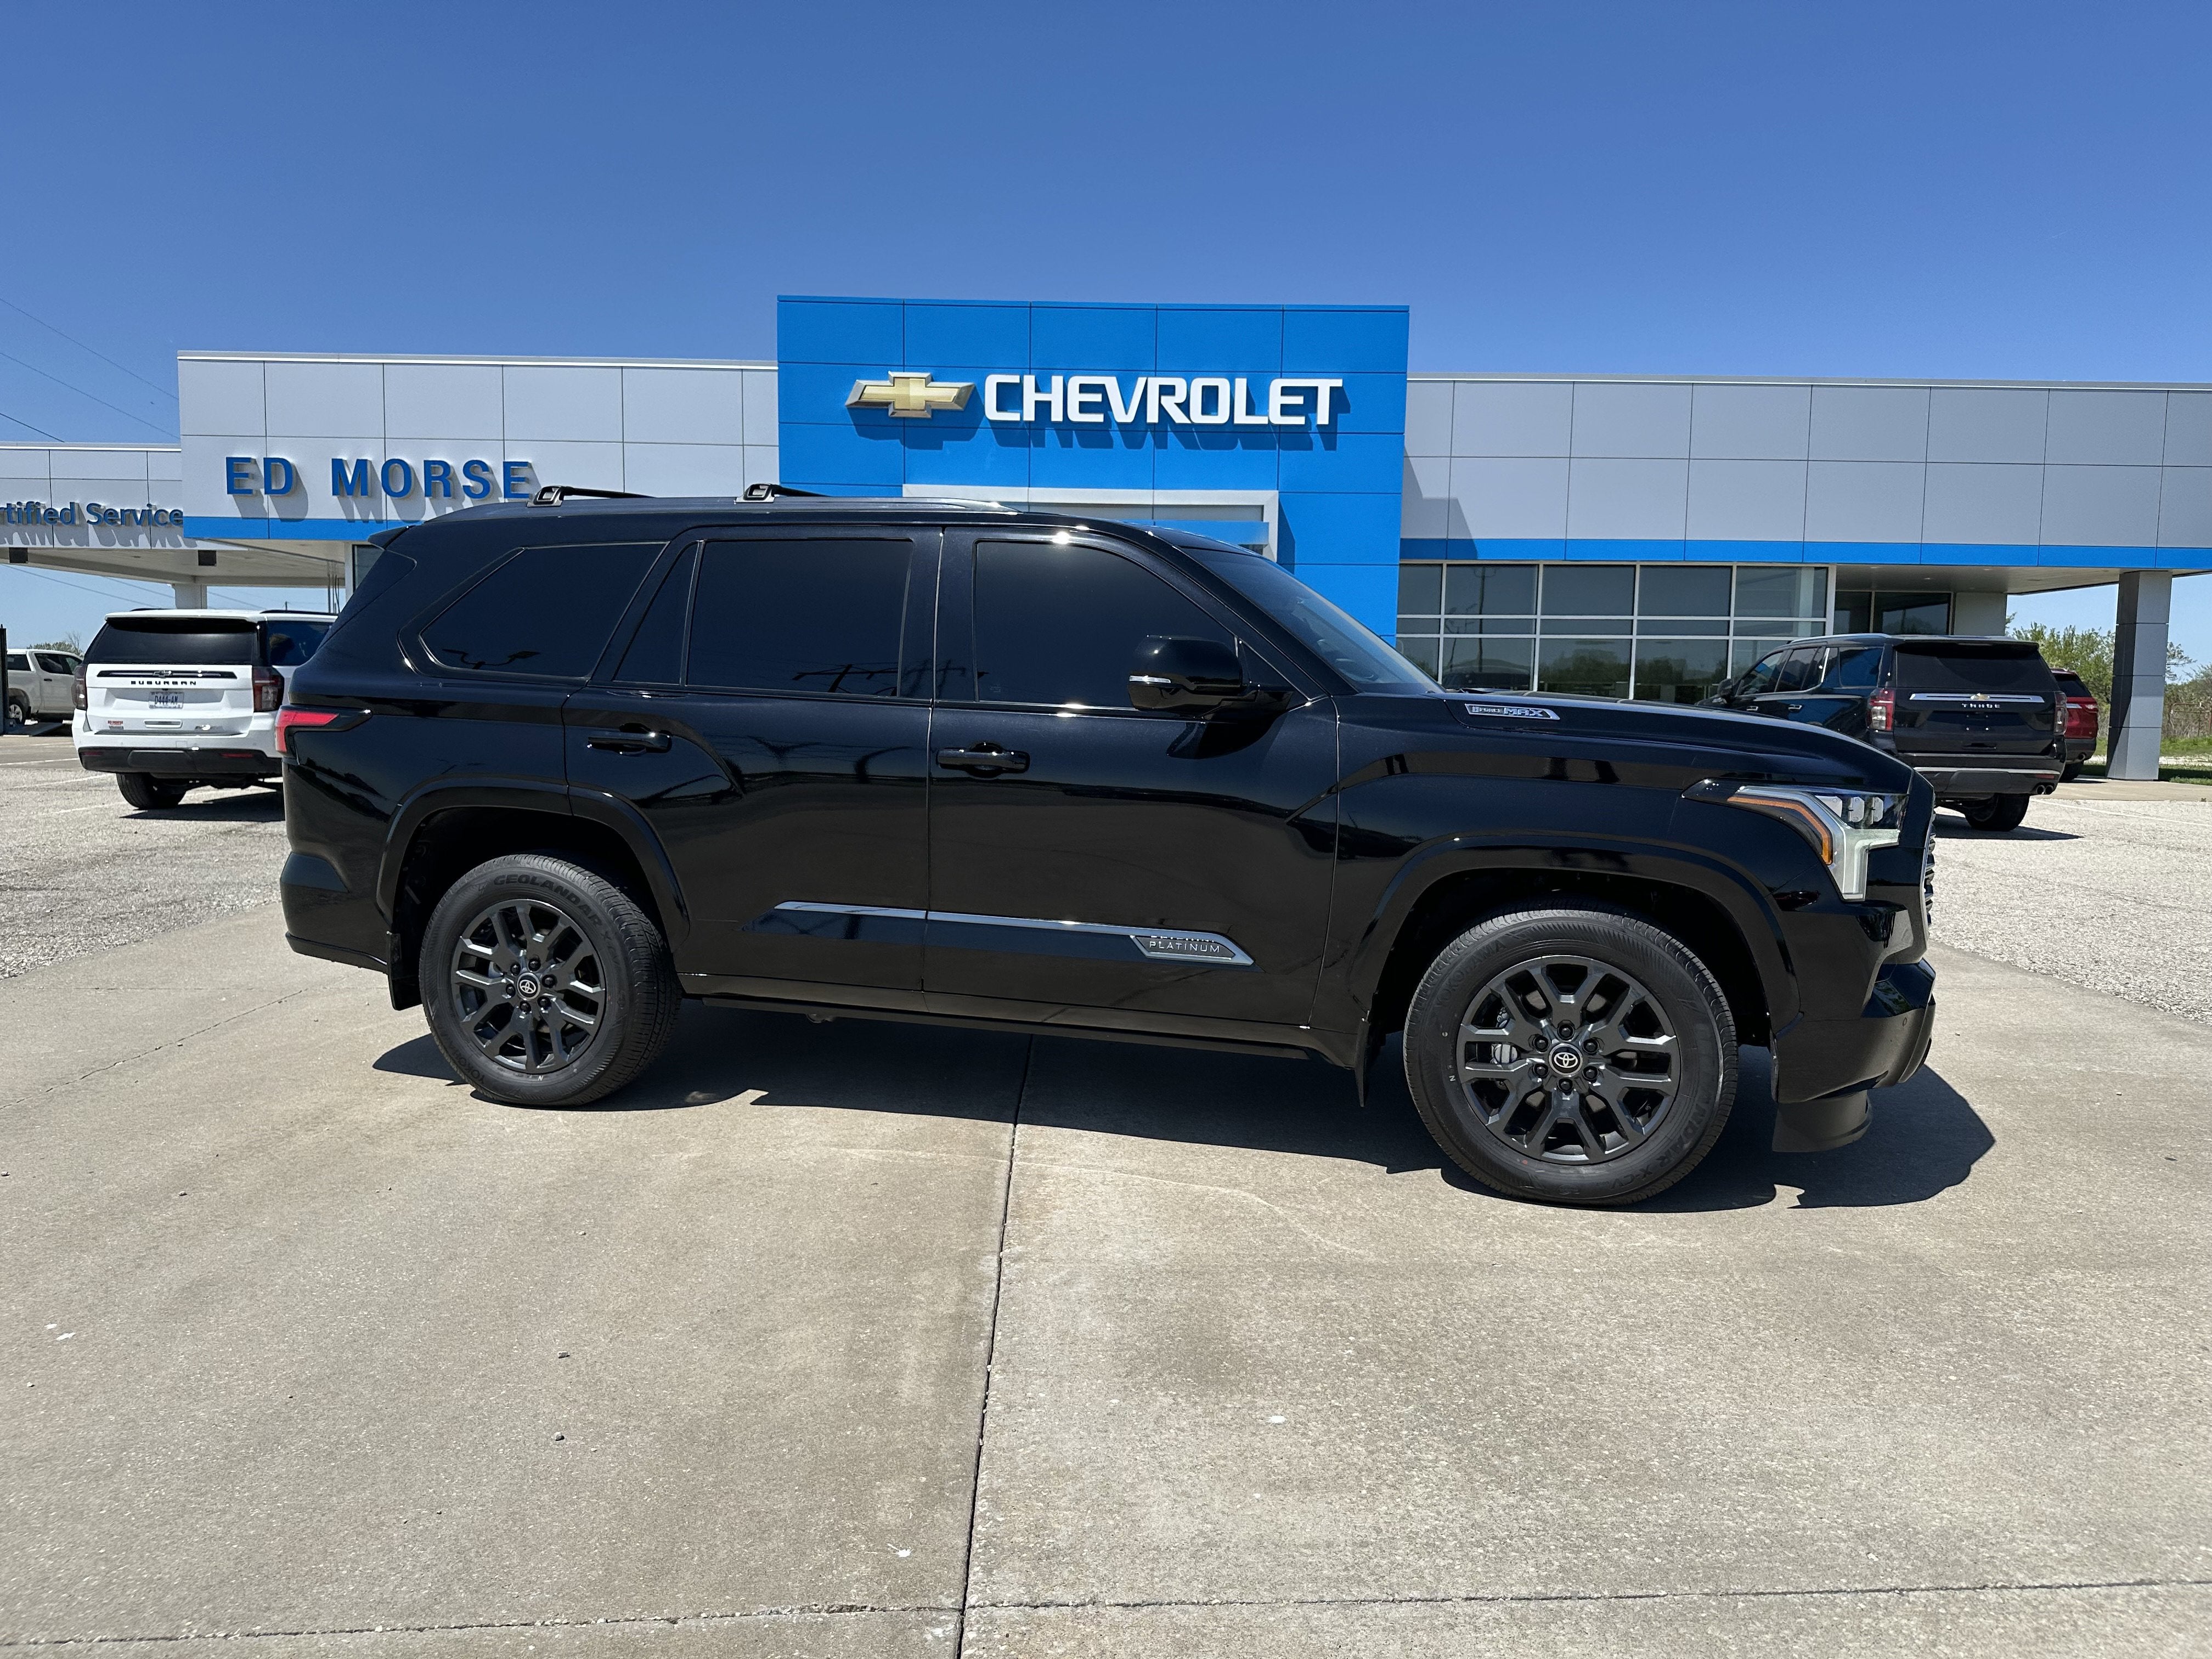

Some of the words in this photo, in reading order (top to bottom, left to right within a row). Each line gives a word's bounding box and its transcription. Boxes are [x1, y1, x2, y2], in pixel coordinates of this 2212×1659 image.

[985, 374, 1342, 425] CHEVROLET
[225, 456, 294, 495] ED
[331, 458, 532, 499] MORSE
[86, 503, 183, 526] Service
[1504, 707, 1544, 717] MAX
[493, 873, 603, 927] GEOLANDAR
[1149, 940, 1220, 953] PLATINUM
